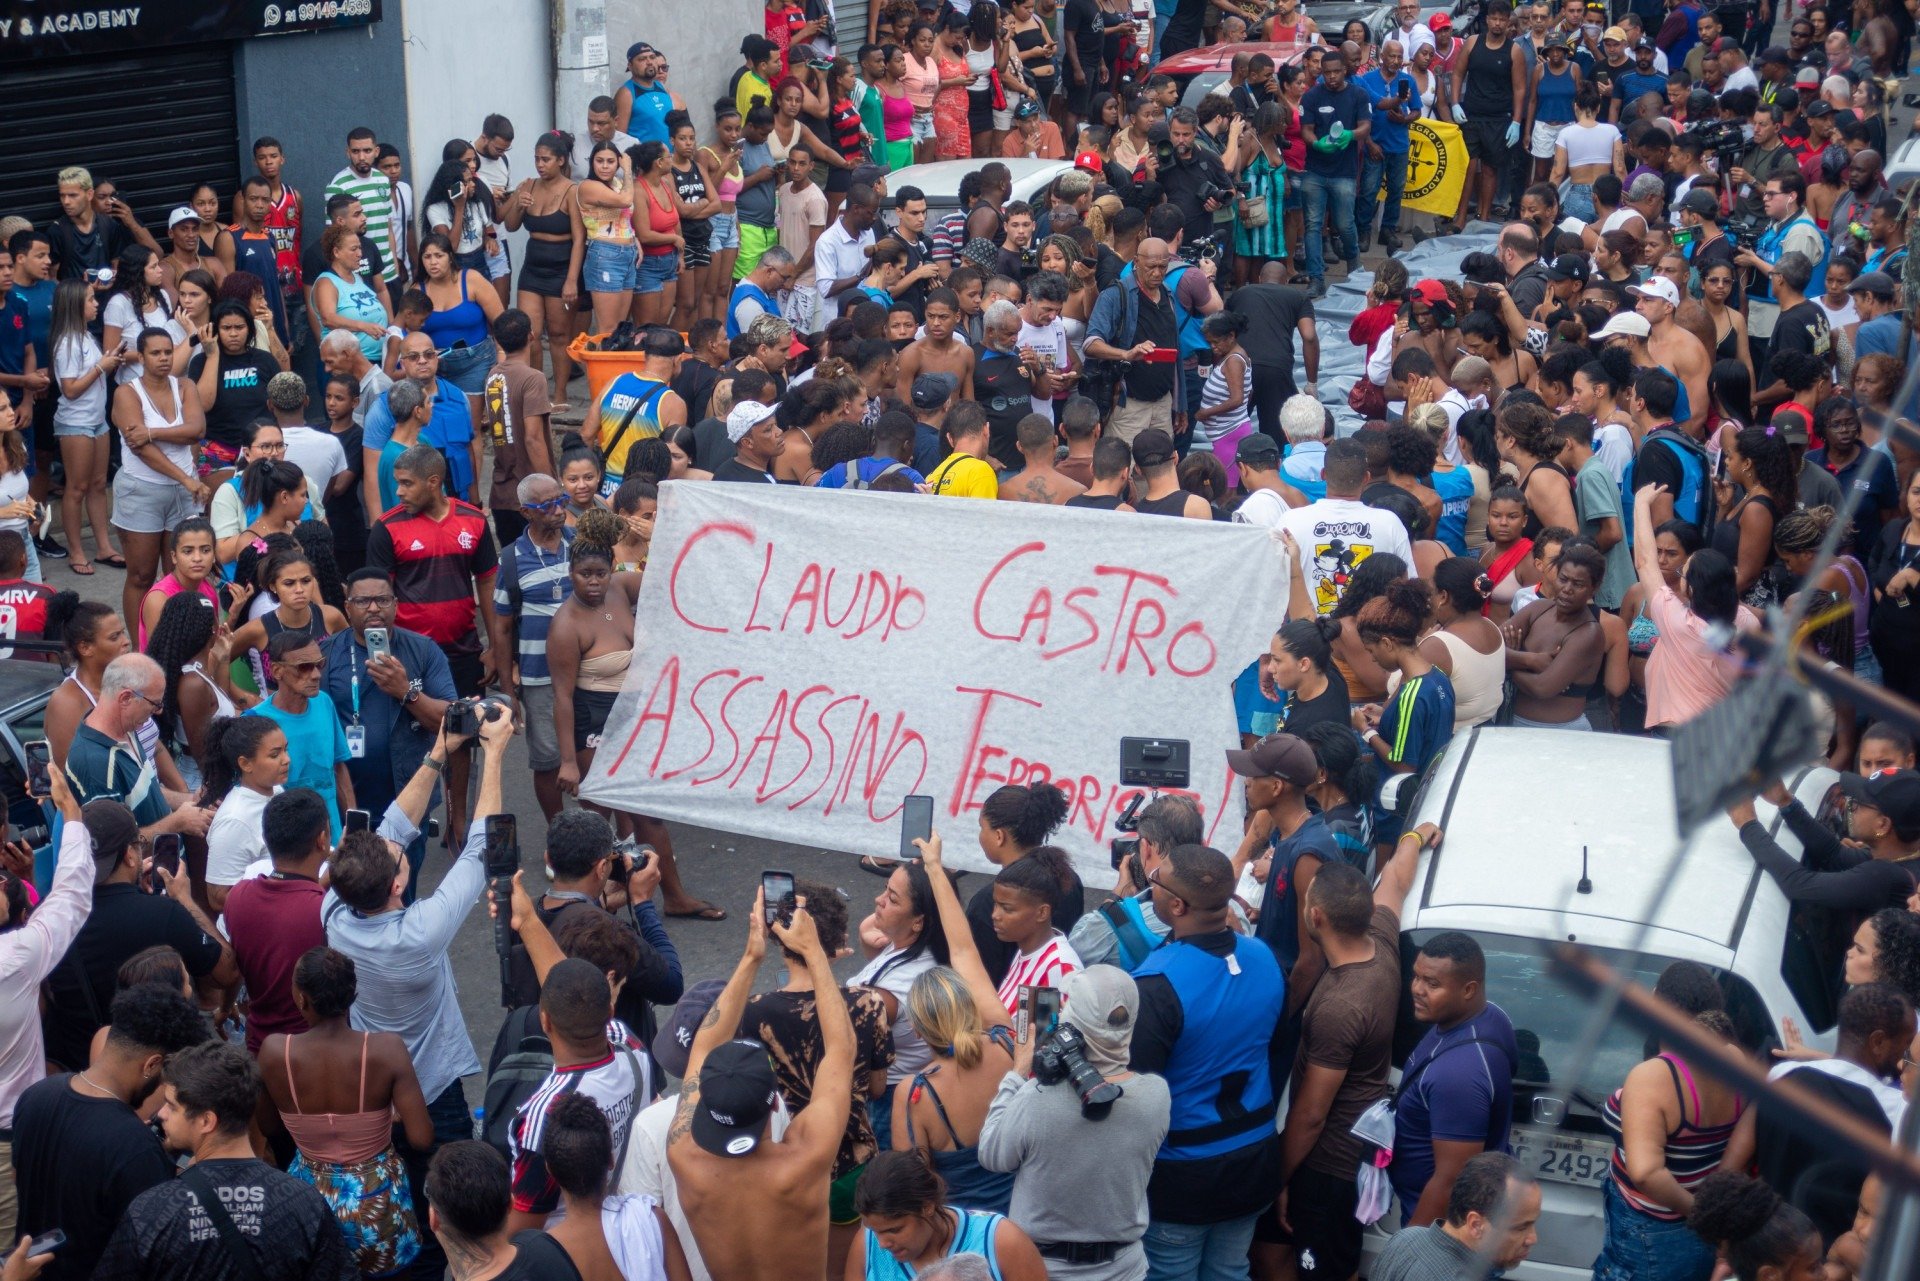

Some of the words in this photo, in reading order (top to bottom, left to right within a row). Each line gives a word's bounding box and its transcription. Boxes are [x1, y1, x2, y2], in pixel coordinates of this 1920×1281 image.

[20, 18, 34, 36] &
[41, 8, 141, 34] ACADEMY
[285, 9, 297, 23] 21
[299, 0, 372, 21] 99146-4599
[1410, 122, 1436, 141] EGRO
[1421, 141, 1448, 196] UNIFICADO
[678, 183, 705, 196] SPURS
[0, 589, 38, 605] MRV
[973, 541, 1219, 678] CASTRO
[607, 654, 929, 823] ASSASSINO
[1539, 1148, 1611, 1181] 2492
[187, 1186, 265, 1206] TDOS
